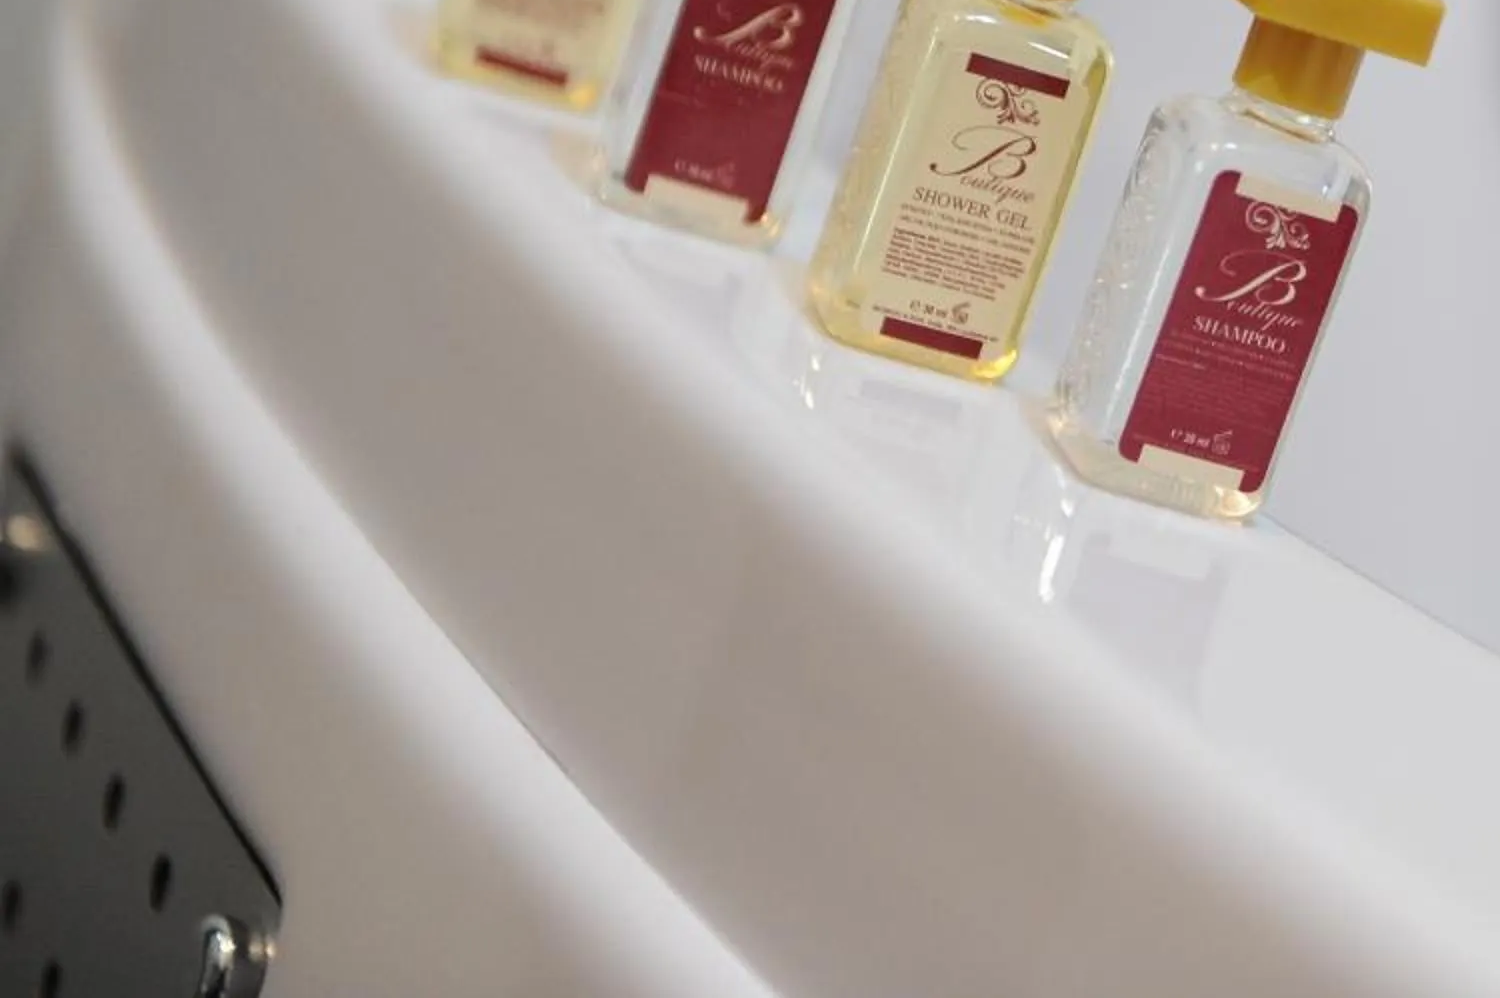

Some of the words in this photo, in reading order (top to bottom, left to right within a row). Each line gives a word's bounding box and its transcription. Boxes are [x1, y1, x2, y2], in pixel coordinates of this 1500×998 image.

[929, 124, 1036, 204] Boutique
[912, 186, 990, 220] SHOWER
[996, 206, 1032, 231] GEL
[1192, 314, 1287, 354] SHAMPOO
